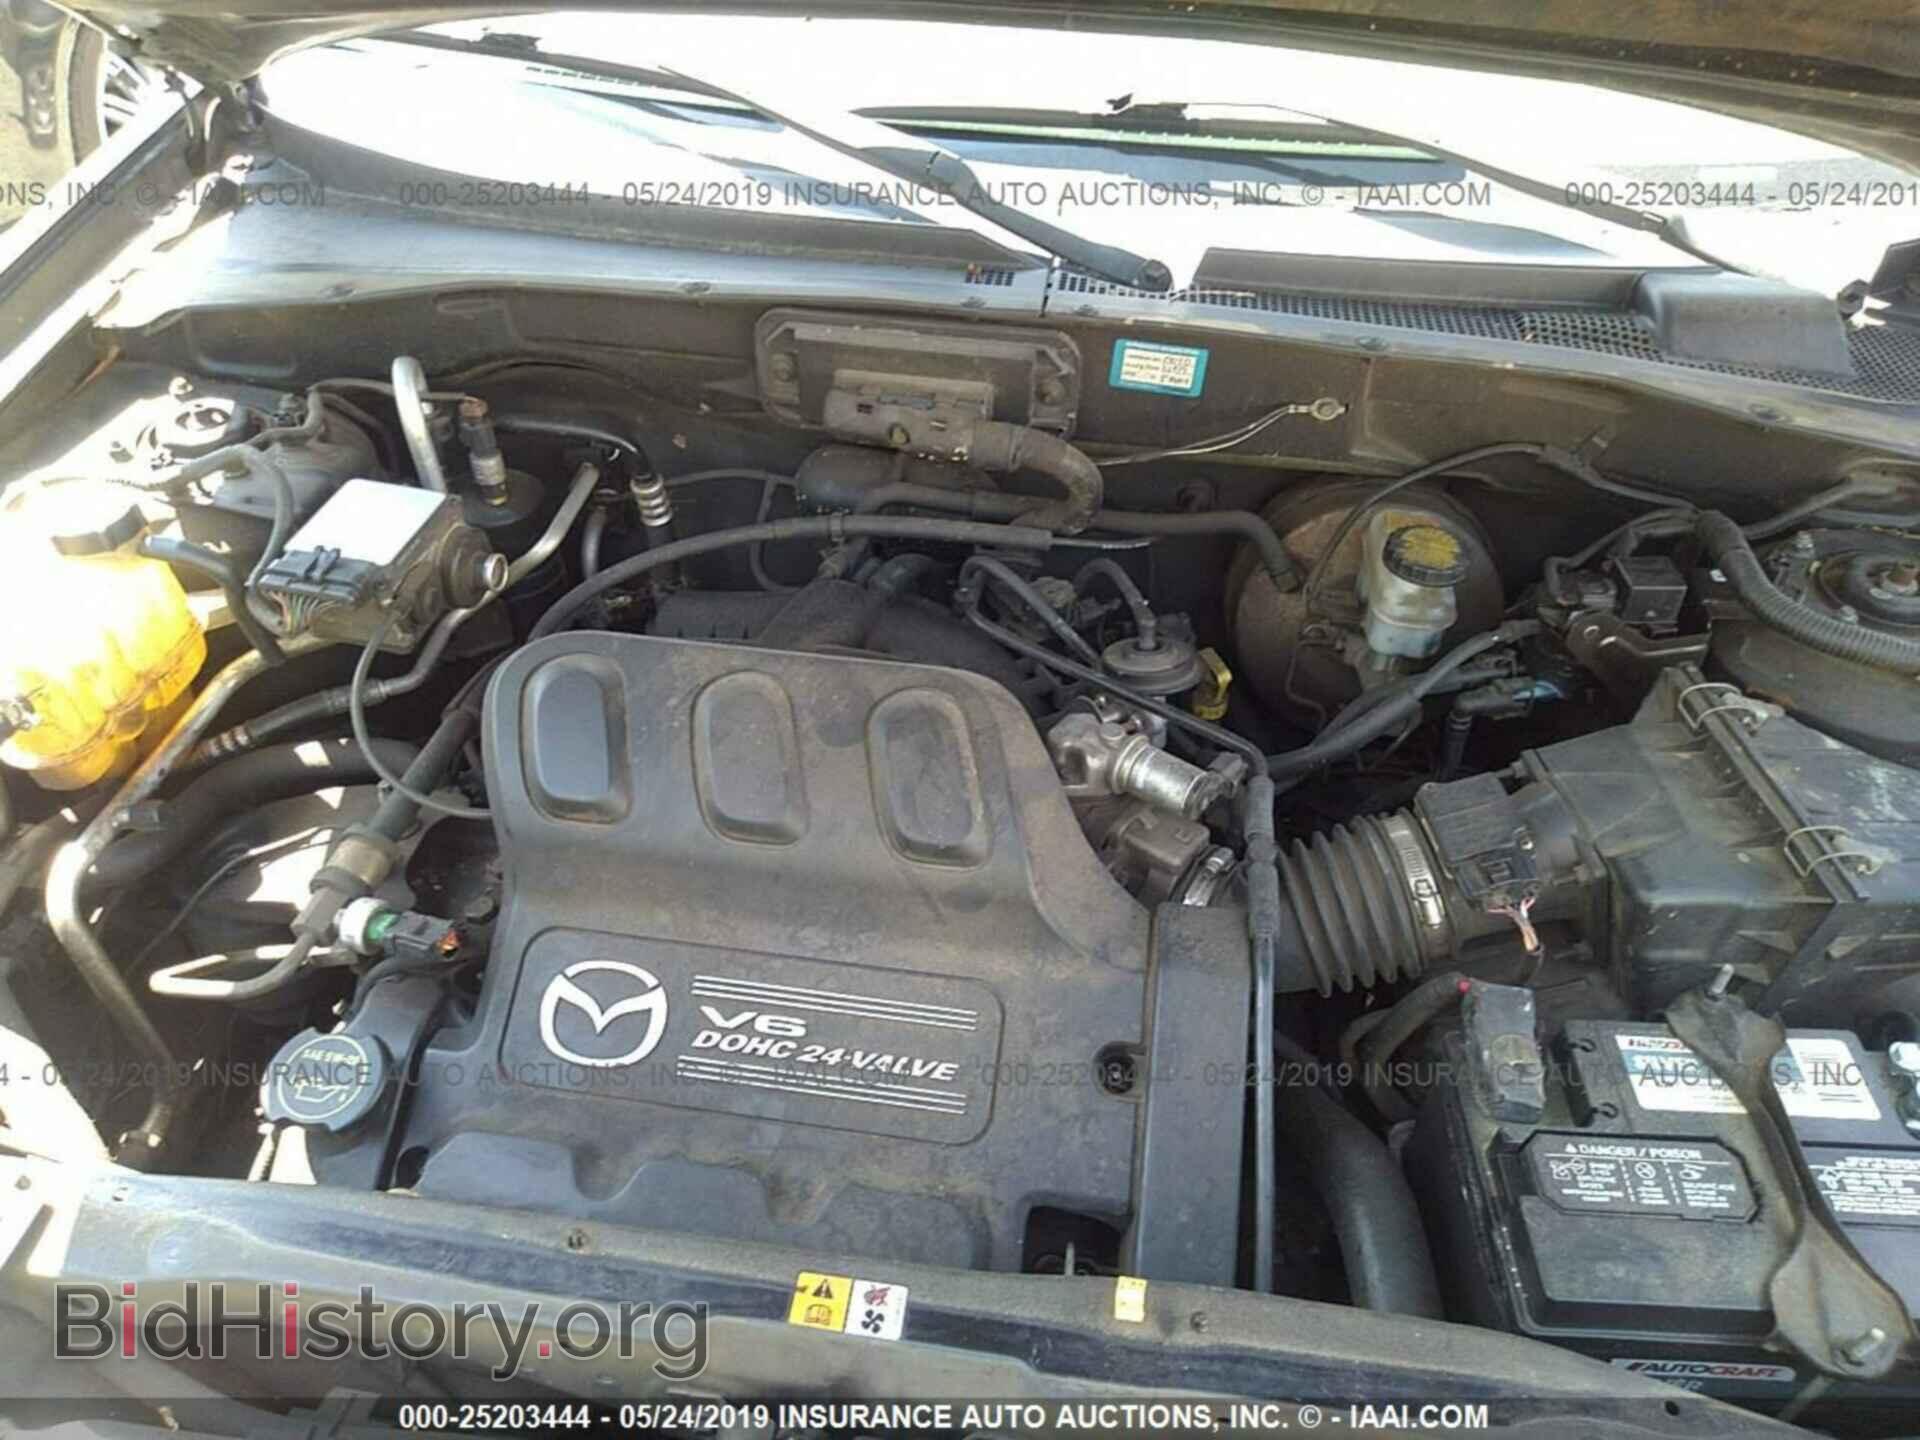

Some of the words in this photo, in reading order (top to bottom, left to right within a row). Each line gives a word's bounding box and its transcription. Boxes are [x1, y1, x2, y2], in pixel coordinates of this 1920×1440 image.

[699, 1005, 808, 1038] V6
[691, 1030, 800, 1059] DOHC
[1578, 1144, 1636, 1157] DANGER
[1649, 1147, 1702, 1160] POISON
[1642, 1362, 1778, 1377] AUTOCRAFT
